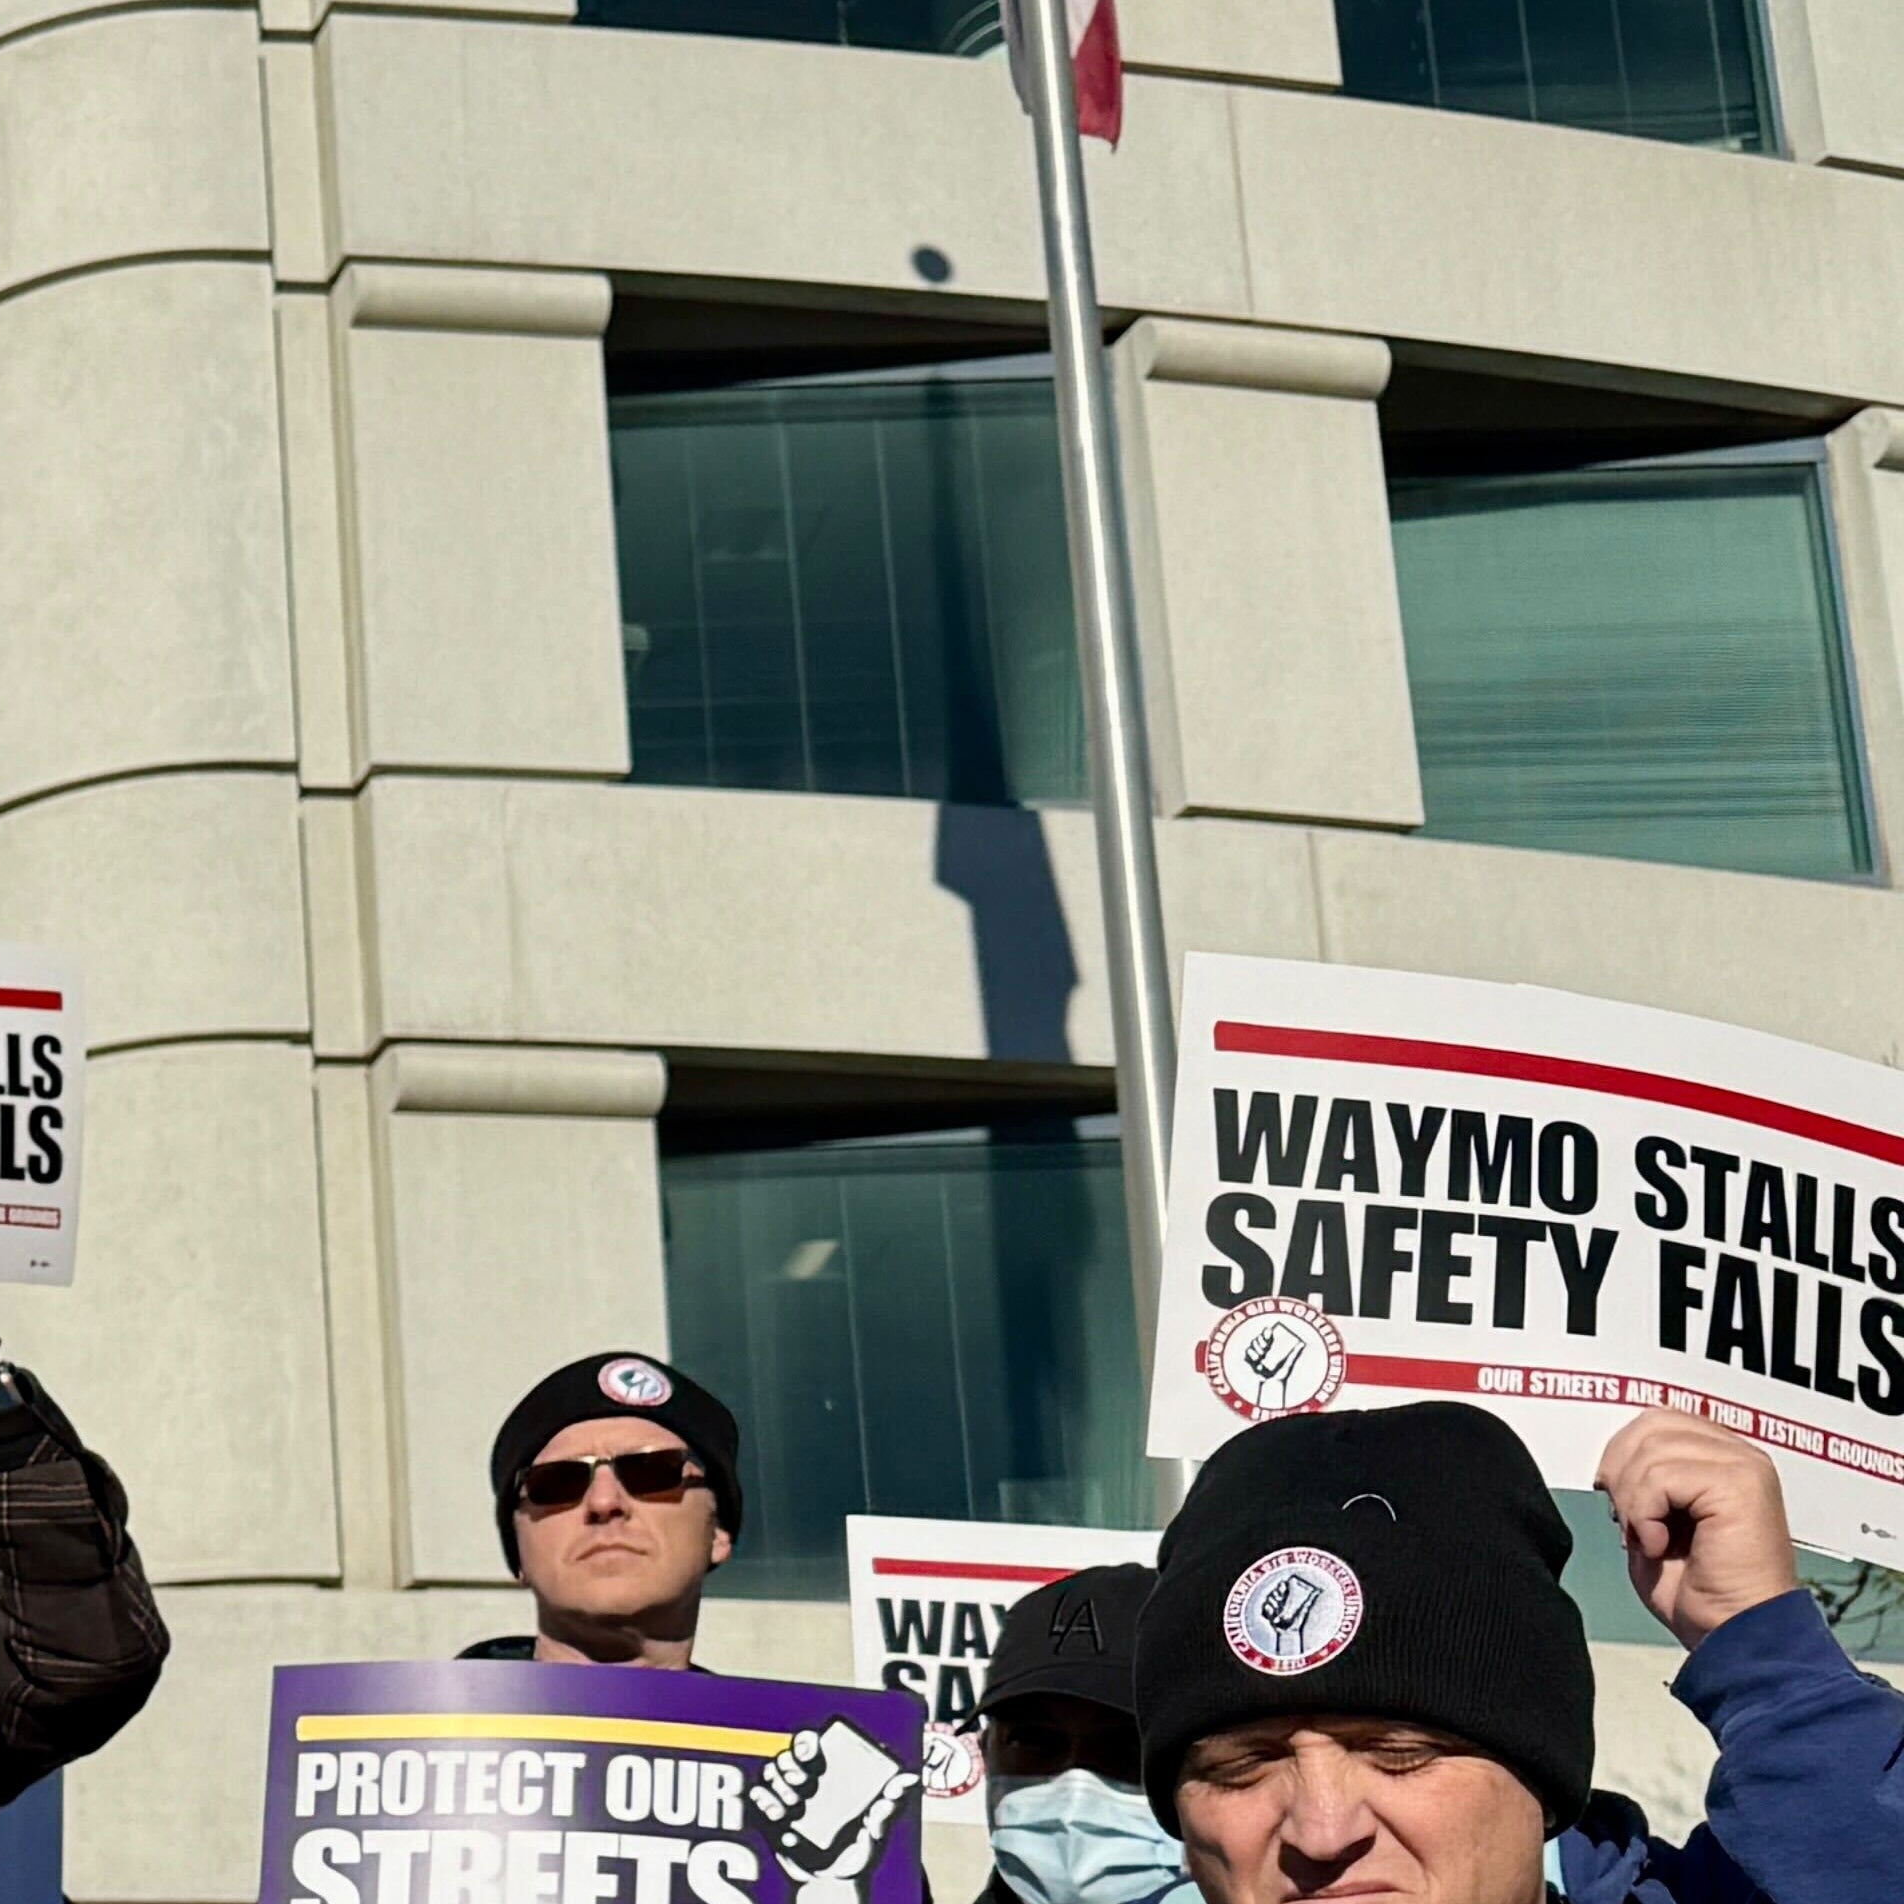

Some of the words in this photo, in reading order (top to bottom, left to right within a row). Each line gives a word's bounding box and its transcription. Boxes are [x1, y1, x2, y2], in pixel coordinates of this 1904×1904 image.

[1213, 1088, 1600, 1216] WAYMO
[1634, 1136, 1904, 1293] STALLS
[1201, 1193, 1620, 1337] SAFETY
[1478, 1367, 1523, 1392] OUR
[1529, 1373, 1620, 1400] STREETS
[1625, 1381, 1663, 1407] ARE
[1667, 1388, 1703, 1415] NOT
[1708, 1399, 1753, 1434] THEIR
[1759, 1414, 1824, 1455] TESTING
[1828, 1437, 1904, 1480] GROUNDS
[1049, 1592, 1103, 1654] LA
[293, 1749, 585, 1818] PROTECT
[606, 1754, 744, 1832] OUR
